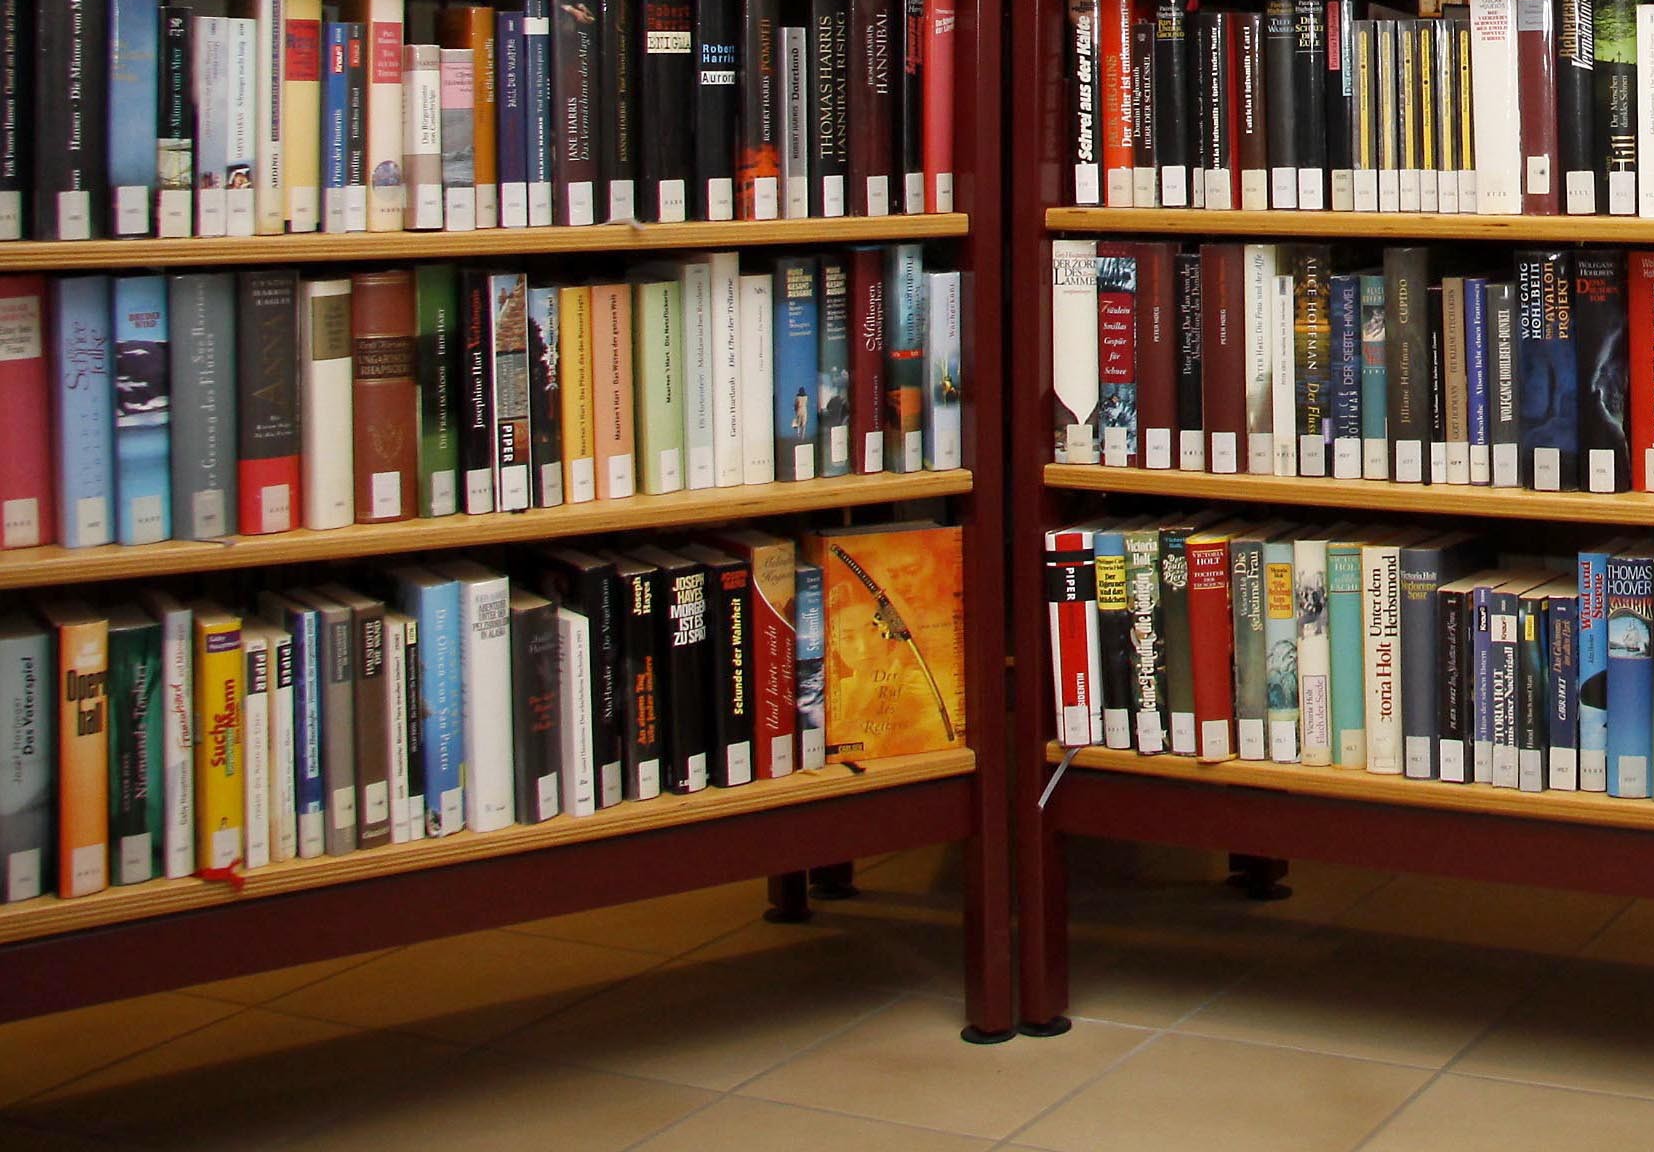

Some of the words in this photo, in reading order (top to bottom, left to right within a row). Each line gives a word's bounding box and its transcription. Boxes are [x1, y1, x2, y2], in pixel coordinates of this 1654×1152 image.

[819, 15, 832, 89] HARRIS
[875, 9, 887, 94] HANNIBAL
[820, 92, 833, 158] THOMAS
[1519, 262, 1528, 340] WOLFGANG
[1532, 263, 1541, 339] HOHLBEIN
[474, 351, 484, 369] Hart
[474, 371, 486, 429] Josephine
[502, 424, 514, 464] PIPER
[1234, 552, 1246, 574] Die
[1246, 551, 1259, 585] Frau
[1370, 567, 1381, 598] dem
[1607, 565, 1652, 580] THOMAS
[633, 576, 643, 616] Joseph
[1065, 568, 1075, 600] PIPER
[1607, 580, 1651, 594] HOOVER
[731, 598, 742, 645] Wahrheit
[1247, 587, 1263, 631] geheime
[1370, 601, 1382, 636] Unter
[733, 648, 743, 669] der
[1375, 642, 1392, 679] Holt
[733, 669, 743, 715] Sekunde
